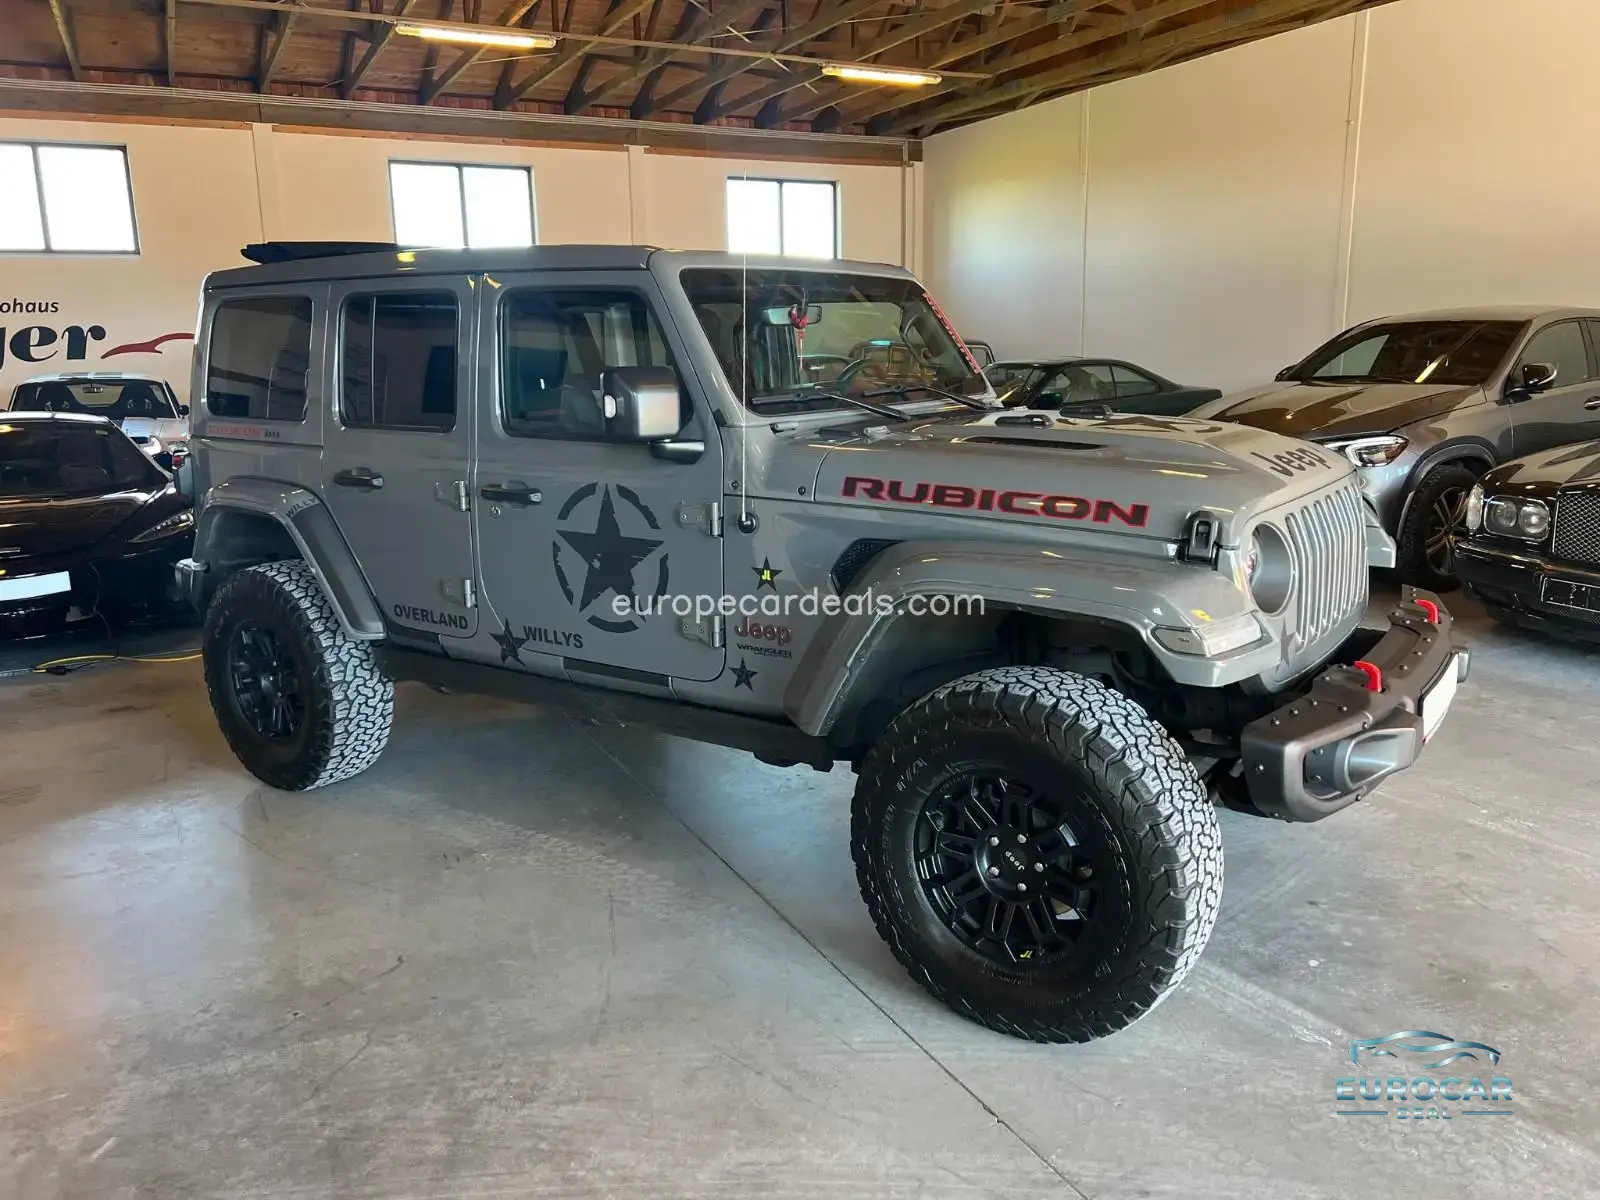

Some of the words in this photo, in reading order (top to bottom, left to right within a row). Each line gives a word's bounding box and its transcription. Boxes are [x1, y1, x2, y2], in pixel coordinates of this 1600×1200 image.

[1250, 447, 1332, 477] Jeep
[841, 476, 1149, 528] RUBICON
[762, 570, 771, 580] JL
[393, 604, 468, 630] OVERLAND
[523, 625, 584, 649] WILLYS
[734, 616, 792, 647] Jeep
[736, 643, 792, 659] WRANGLER
